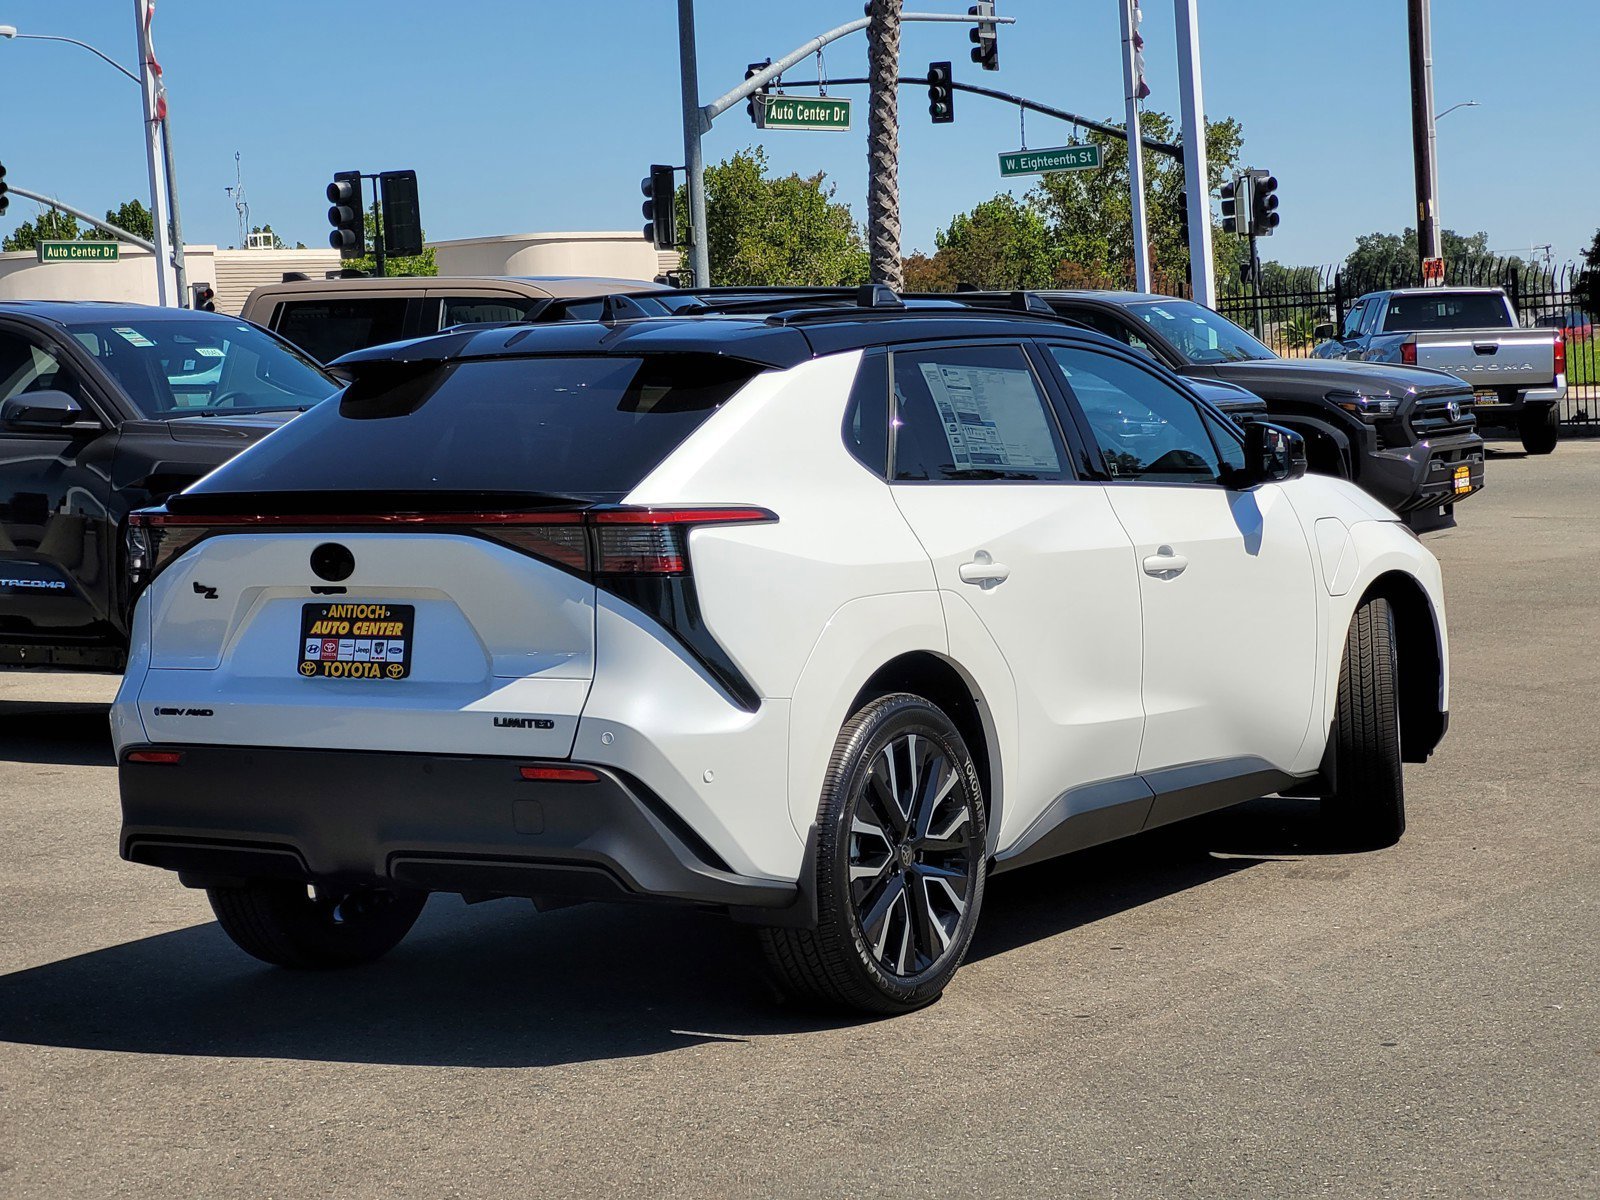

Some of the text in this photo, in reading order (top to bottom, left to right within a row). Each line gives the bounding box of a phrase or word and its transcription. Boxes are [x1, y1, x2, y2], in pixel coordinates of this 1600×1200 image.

[769, 104, 846, 122] Auto Center Dr
[1005, 151, 1092, 171] W. Eighteenth St
[47, 246, 115, 257] Auto Center Dr
[1439, 363, 1533, 373] TACOMA
[0, 579, 66, 589] TACOMA
[328, 604, 386, 619] ANTIOCH
[310, 621, 404, 636] AUTO CENTER
[355, 646, 369, 654] Jeep
[323, 661, 381, 677] TOYOTA
[493, 716, 555, 729] LIMITED
[963, 756, 985, 833] YOKOHAMA
